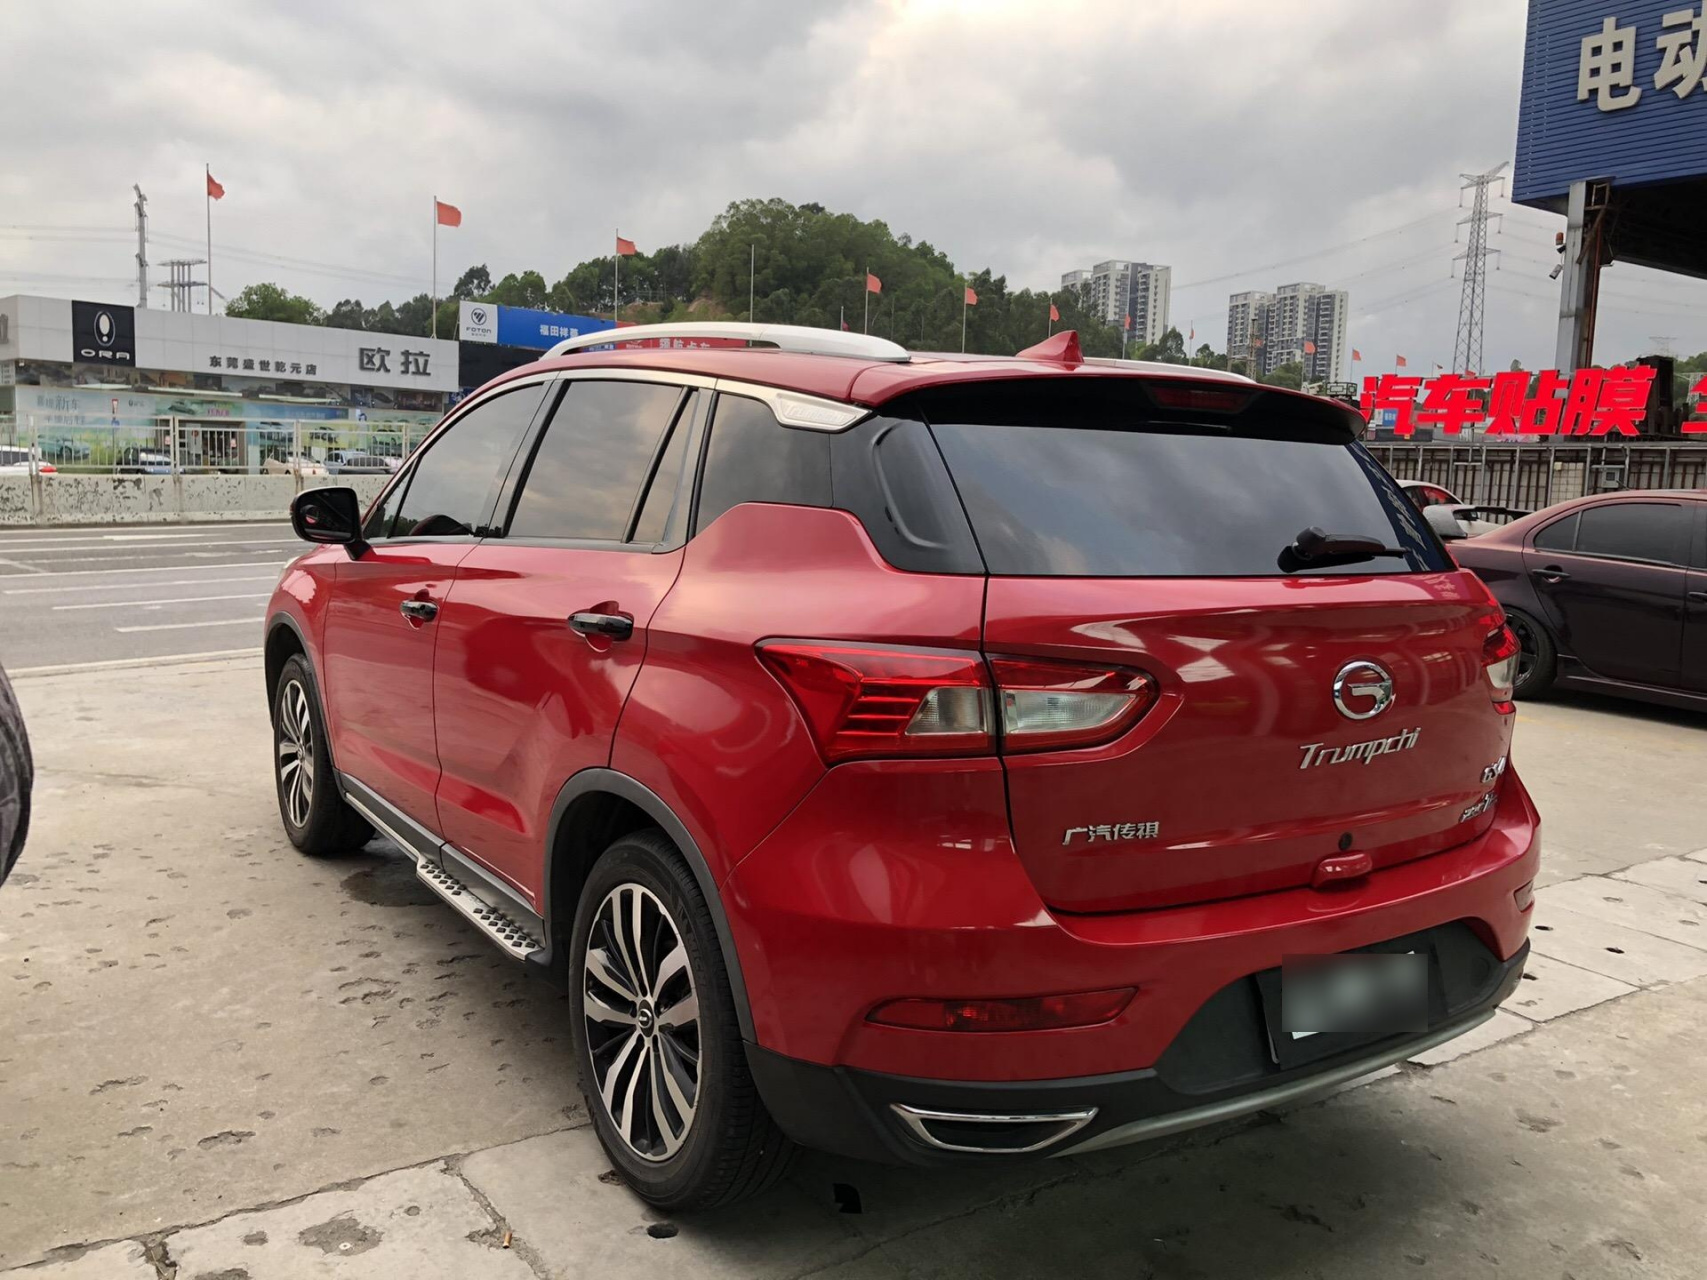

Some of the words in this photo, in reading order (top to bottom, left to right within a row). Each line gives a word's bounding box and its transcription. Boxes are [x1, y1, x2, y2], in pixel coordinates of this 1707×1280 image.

[1577, 0, 1707, 111] 电动
[81, 348, 130, 360] ORA
[209, 355, 317, 376] 东莞盛世乾元店
[358, 347, 432, 376] 欧拉
[1359, 365, 1658, 437] 汽车贴膜
[1299, 727, 1422, 769] Trumpchi
[1062, 821, 1160, 846] 广汽传祺
